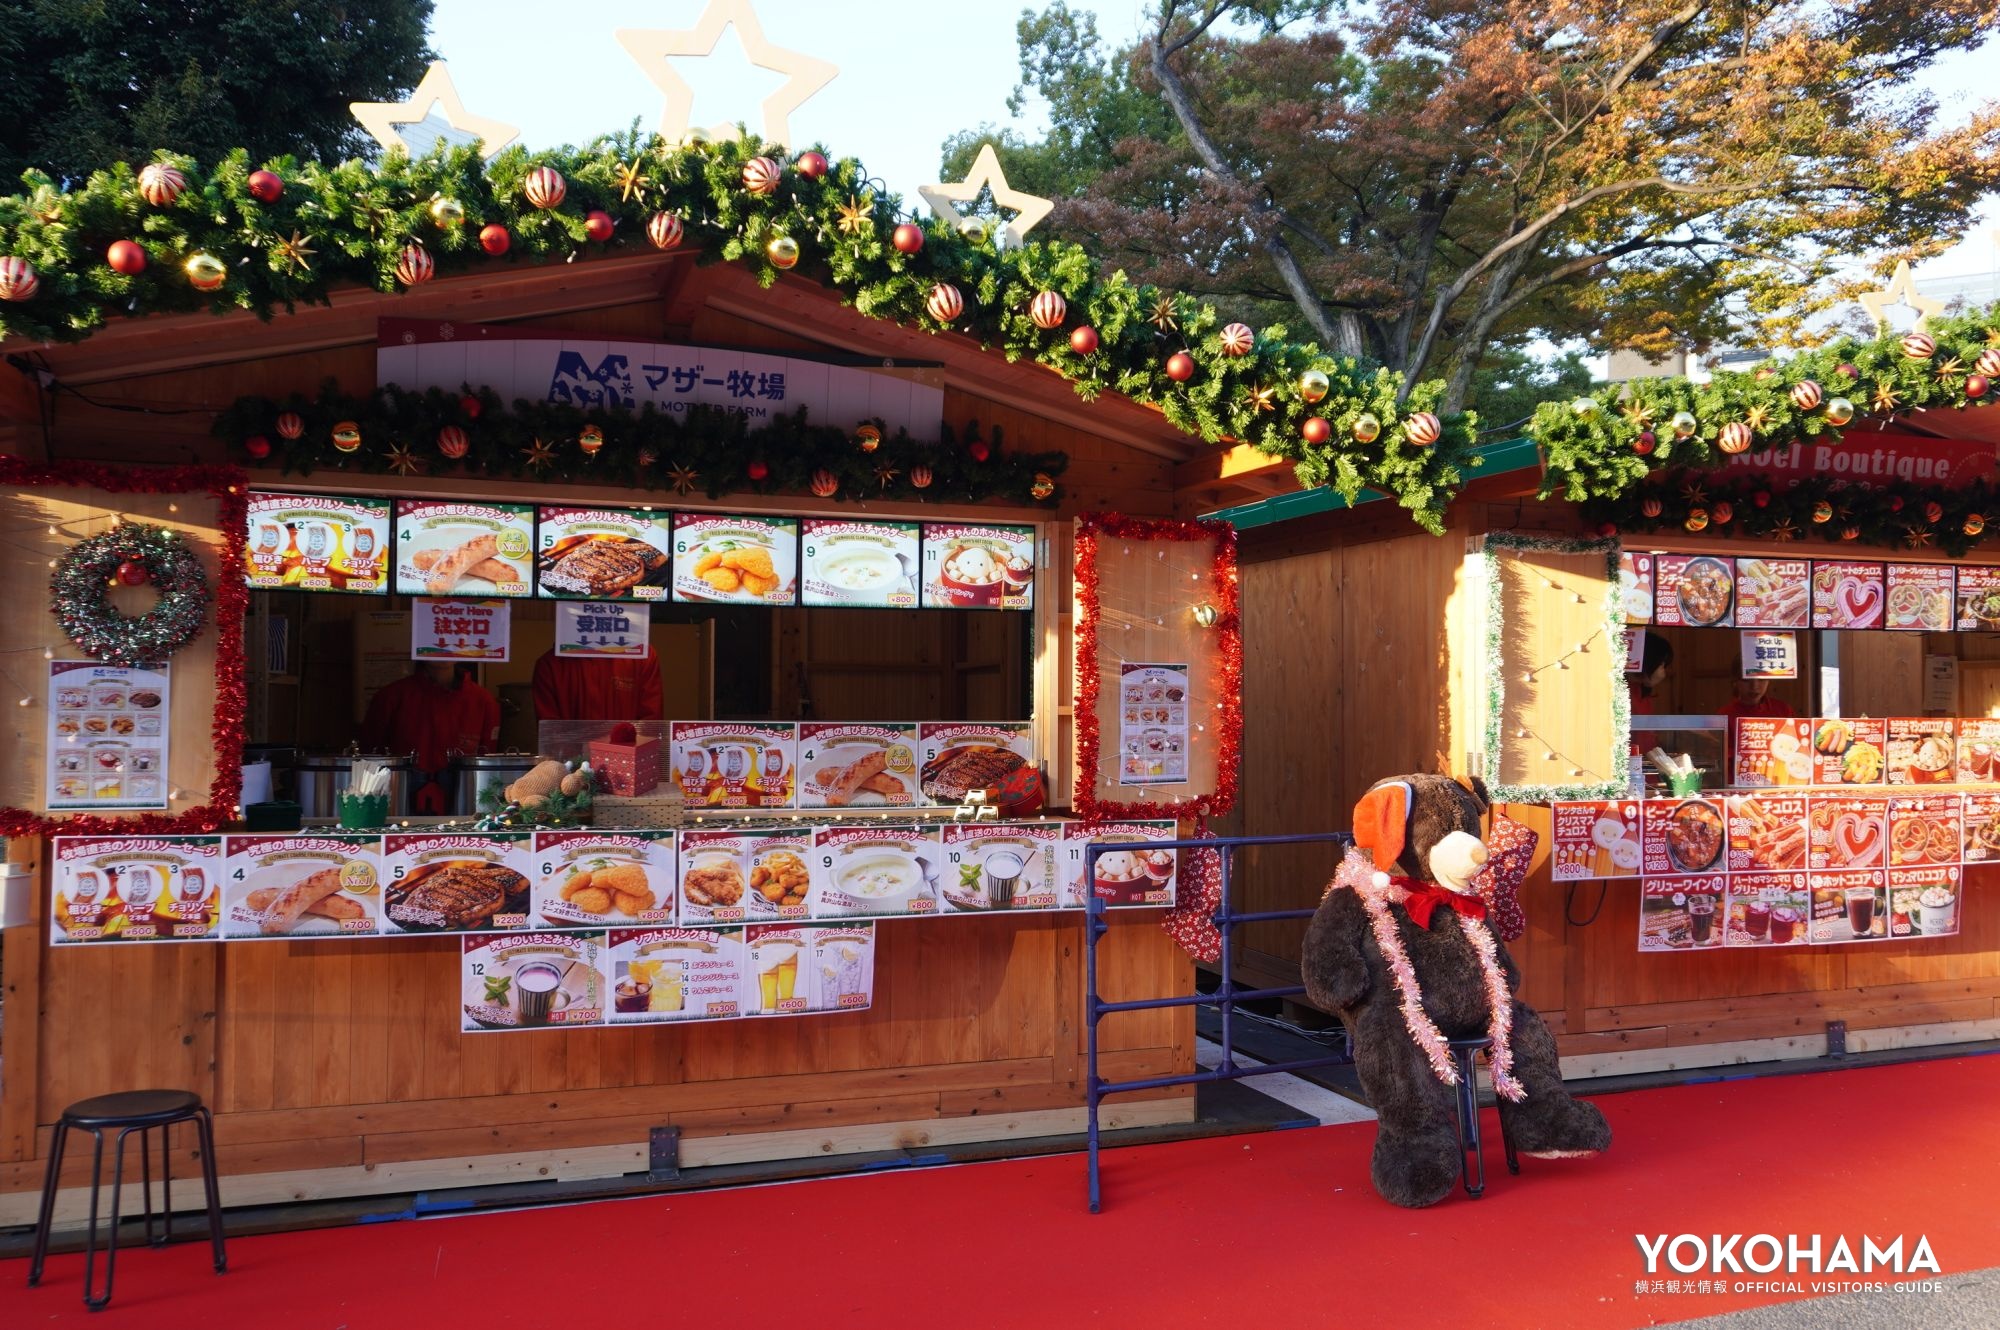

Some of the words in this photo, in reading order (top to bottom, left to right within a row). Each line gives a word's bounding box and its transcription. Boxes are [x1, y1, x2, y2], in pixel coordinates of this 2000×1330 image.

[642, 364, 786, 400] マザー牧場
[1815, 446, 1950, 481] Boutique
[413, 505, 516, 522] 究極の粗びきフランク
[554, 512, 652, 529] 牧場のグリルステーキ
[344, 524, 351, 532] 3
[694, 519, 776, 535] カマンベールフライ
[812, 523, 907, 539] 牧場のクラムチャウダー
[401, 530, 411, 541] 4
[544, 536, 553, 546] 5
[930, 528, 1026, 543] わんちゃんのホットココア
[677, 541, 686, 552] 6
[807, 546, 815, 557] 9
[927, 551, 936, 560] 11
[342, 559, 383, 569] チョリソー
[1659, 562, 1687, 572] ビーフ
[1768, 562, 1806, 575] チュロス
[1658, 573, 1692, 585] シチュー
[636, 588, 661, 597] ¥2200
[432, 605, 463, 616] Order
[466, 607, 493, 616] Here
[584, 605, 606, 614] Pick
[610, 605, 623, 616] Up
[433, 618, 490, 635] 注文口
[577, 617, 629, 632] 受取口
[676, 725, 792, 742] 牧場直送のグリルソーセージ
[816, 725, 901, 741] 究極の粗びきフランク
[935, 726, 1017, 741] 牧場のグリルステーキ
[805, 750, 814, 760] 4
[927, 749, 935, 759] 5
[756, 777, 790, 786] チョリソー
[724, 797, 745, 805] ¥600
[1646, 807, 1675, 818] ビーフ
[1762, 801, 1803, 814] チュロス
[1557, 816, 1595, 826] クリスマス
[1646, 820, 1680, 831] シチュー
[1072, 825, 1168, 840] わんちゃんのホットココア
[1557, 827, 1587, 837] チュロス
[560, 835, 650, 850] カマンベールフライ
[829, 829, 927, 847] 牧場のクラムチャウダー
[61, 840, 218, 861] 牧場直送のグリルソーセージ
[248, 838, 361, 857] 究極の粗びきフランク
[405, 837, 512, 855] 牧場のグリルステーキ
[1646, 845, 1665, 853] ¥900
[949, 852, 961, 864] 10
[1070, 849, 1079, 860] 11
[823, 856, 832, 867] 9
[1646, 862, 1668, 870] ¥1200
[65, 867, 70, 875] 1
[118, 866, 126, 874] 2
[170, 865, 178, 873] 3
[394, 866, 404, 878] 5
[542, 863, 552, 874] 6
[1559, 864, 1581, 874] ¥800
[233, 868, 245, 881] 4
[1733, 875, 1791, 884] ハートのマシュマロ
[1891, 870, 1946, 883] マシュマロココア
[345, 876, 371, 886] No.1
[1646, 879, 1712, 893] グリューワイン
[1714, 879, 1722, 888] 14
[1823, 874, 1872, 887] ホットココア
[912, 901, 932, 909] ¥800
[1033, 896, 1053, 904] ¥700
[168, 902, 214, 912] チョリソー
[783, 907, 804, 915] ¥800
[718, 910, 740, 918] ¥800
[345, 921, 371, 929] ¥700
[495, 916, 524, 924] ¥2200
[72, 929, 98, 937] ¥600
[178, 926, 203, 934] ¥600
[757, 931, 801, 940] ノンアルビール
[490, 934, 582, 951] 究極のいちごみるく
[634, 929, 720, 945] ソフトドリンク各種
[1645, 937, 1664, 945] ¥700
[472, 964, 484, 975] 12
[551, 1012, 563, 1021] HOT
